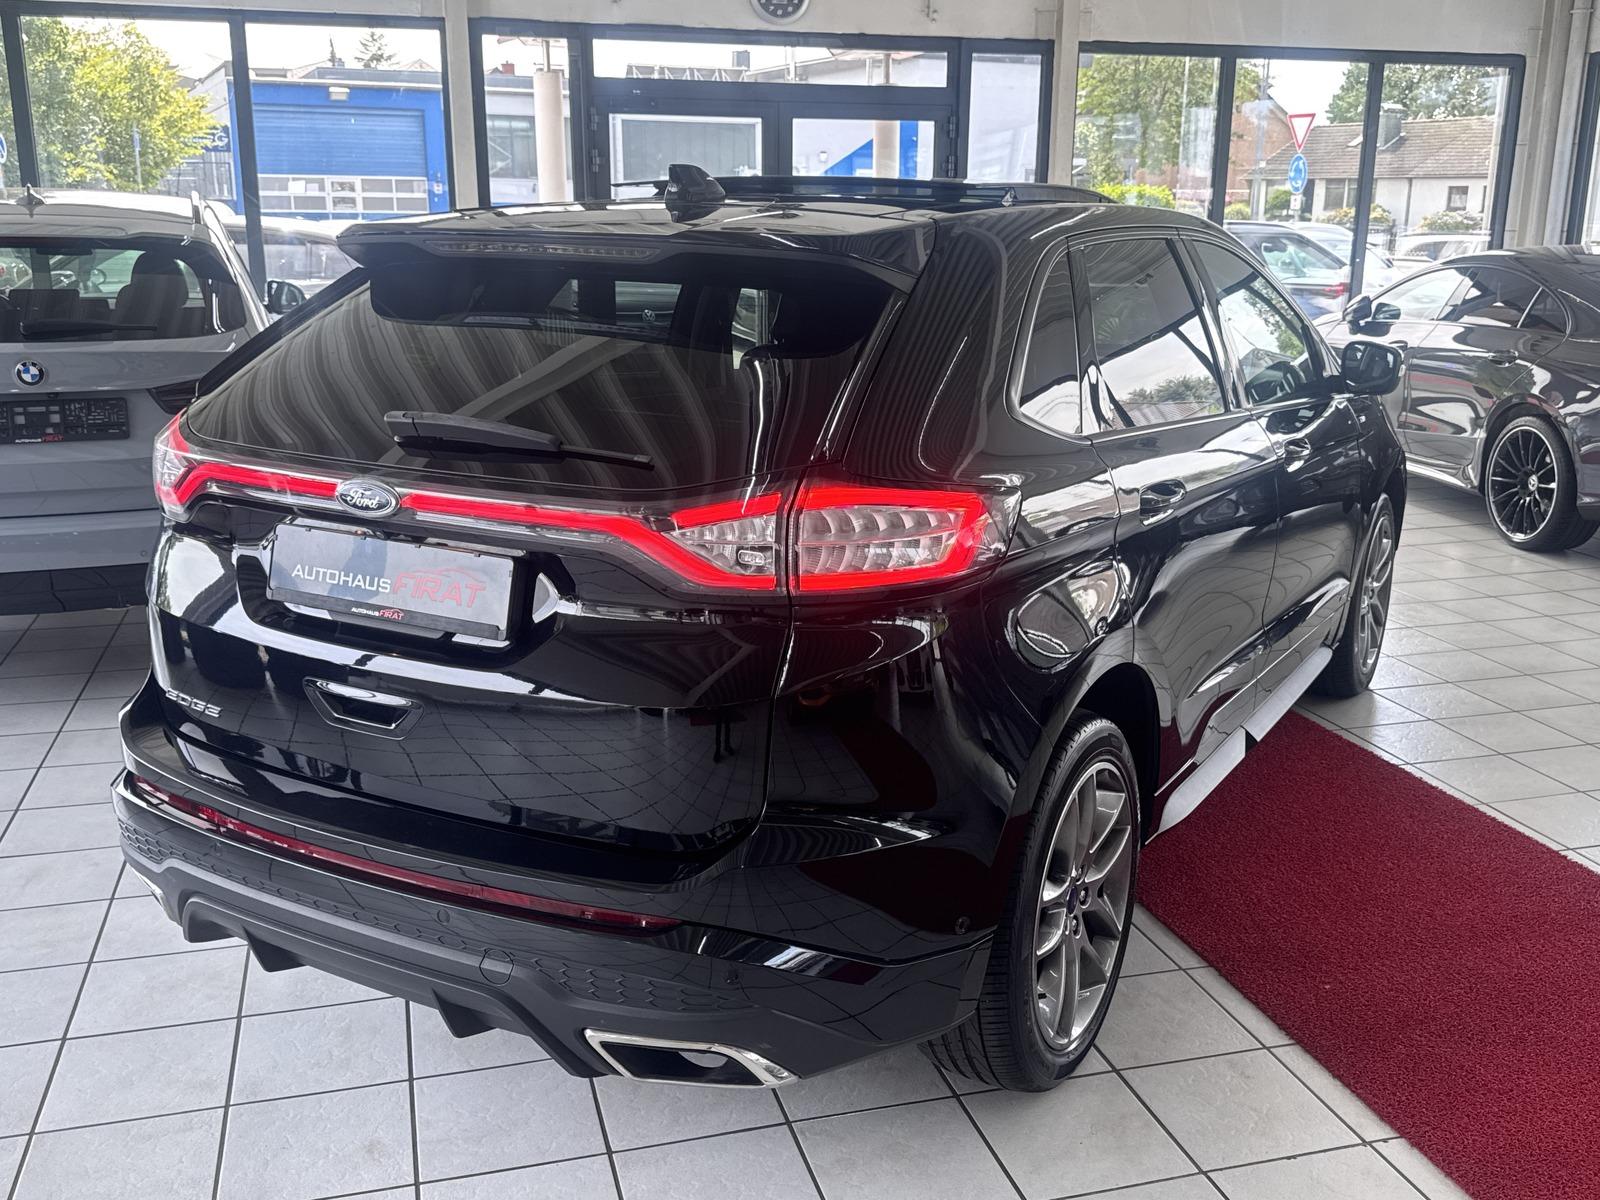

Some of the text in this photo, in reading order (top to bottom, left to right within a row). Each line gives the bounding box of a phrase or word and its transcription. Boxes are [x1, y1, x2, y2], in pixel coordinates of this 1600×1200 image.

[341, 488, 380, 509] Ford
[291, 564, 487, 608] AUTOHAUS FIRAT
[351, 606, 404, 620] AUTOHAUS FIRAT
[165, 687, 222, 718] EDGE
